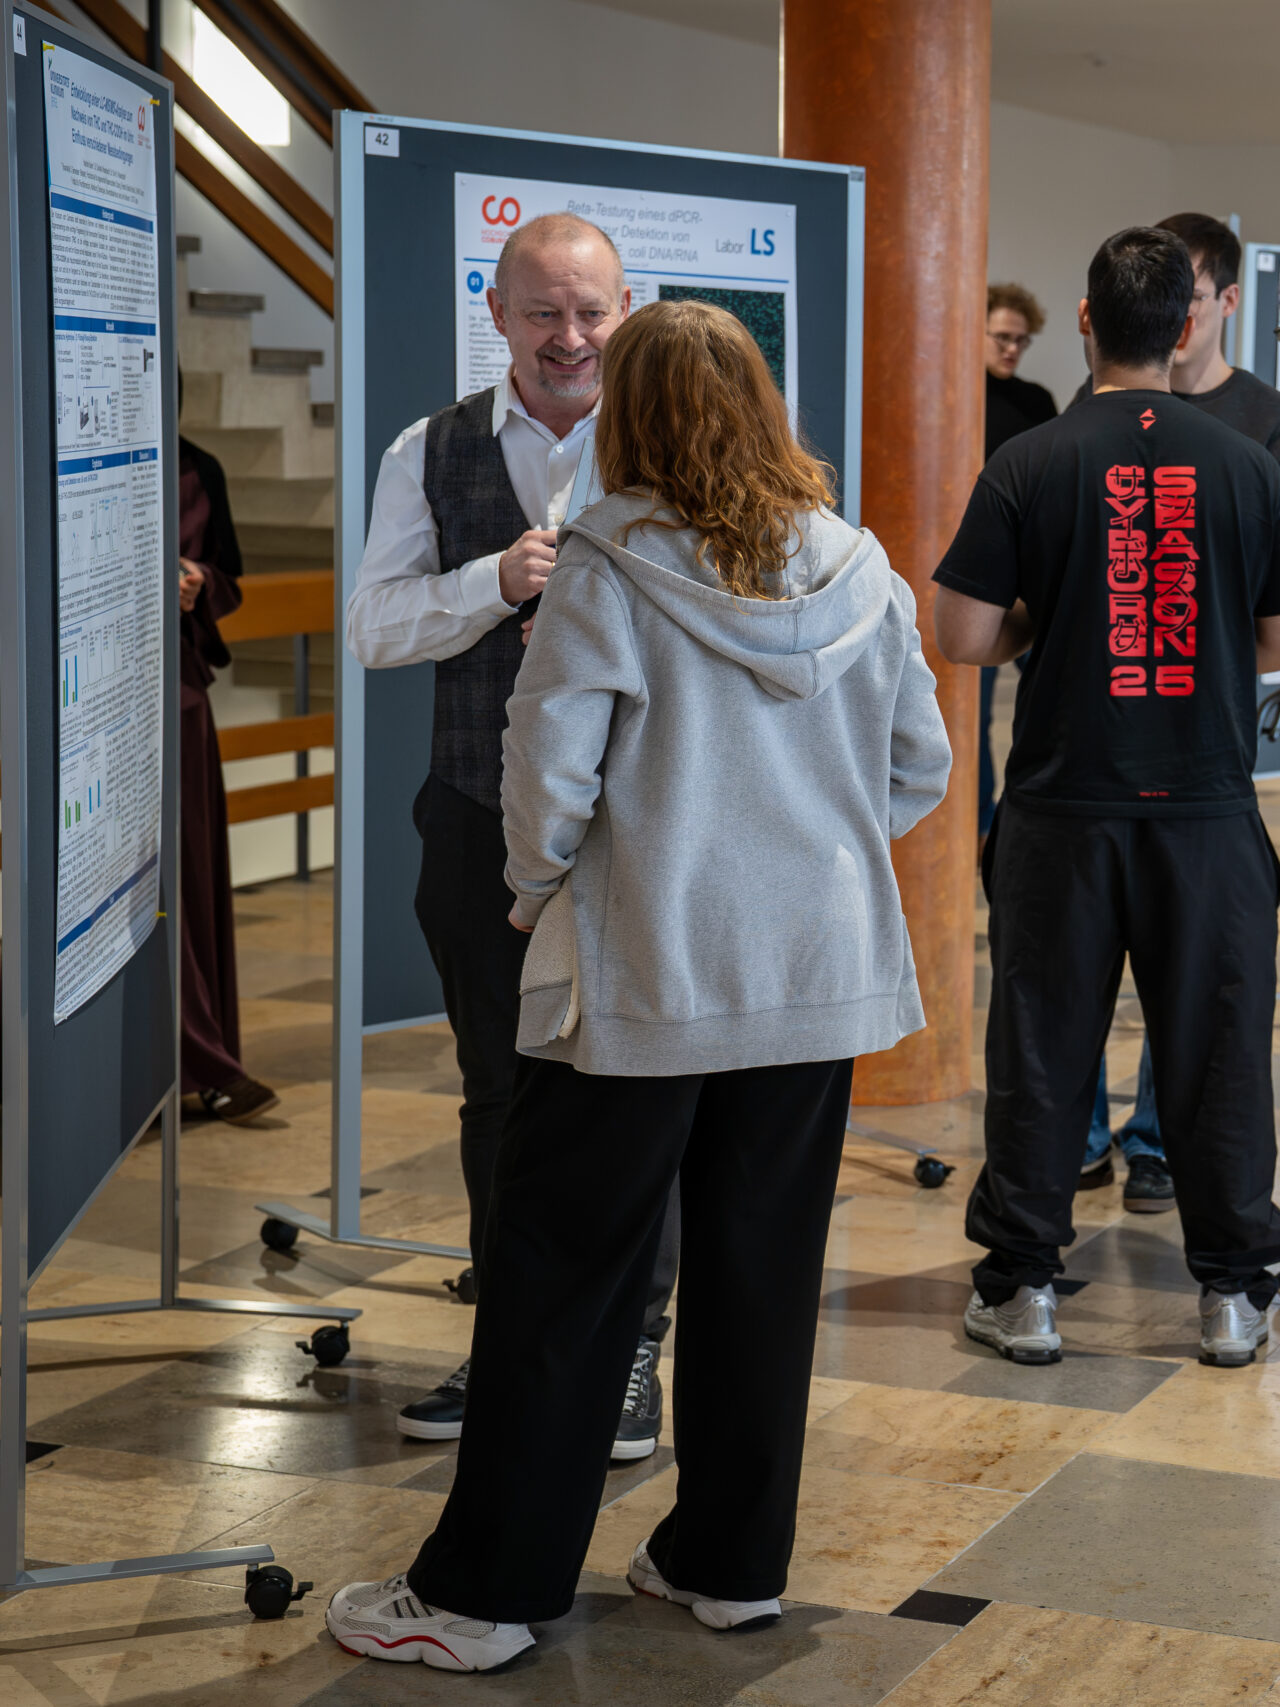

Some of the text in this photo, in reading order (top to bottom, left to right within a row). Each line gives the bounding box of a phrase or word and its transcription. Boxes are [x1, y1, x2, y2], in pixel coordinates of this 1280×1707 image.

[375, 132, 389, 146] 42
[567, 199, 703, 225] Beta-Testung eines dPCR-
[621, 224, 669, 242] Detektion
[672, 232, 690, 243] von
[715, 227, 776, 256] Labor LS
[628, 246, 647, 259] coli
[648, 246, 699, 263] DNA/RNA
[470, 277, 480, 287] 01
